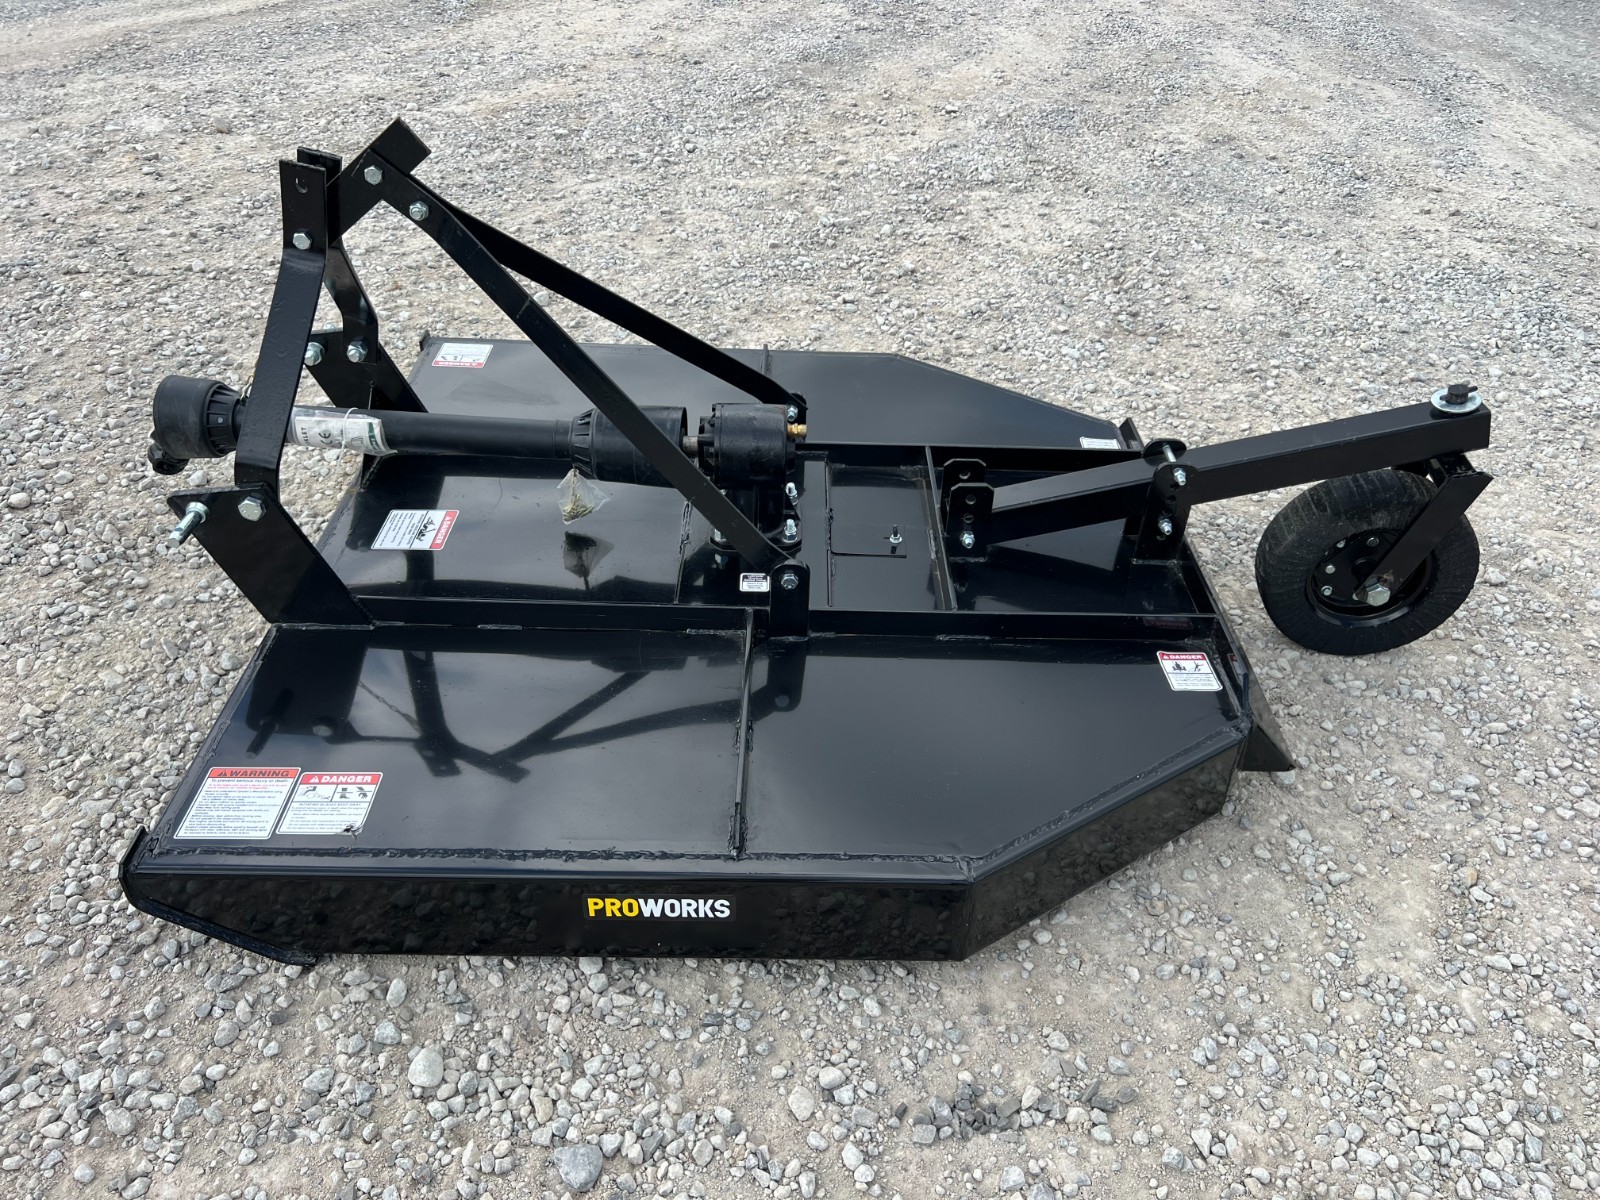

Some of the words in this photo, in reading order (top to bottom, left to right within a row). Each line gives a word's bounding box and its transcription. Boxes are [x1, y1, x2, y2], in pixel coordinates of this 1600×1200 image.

[433, 520, 452, 544] DANGER
[321, 775, 372, 783] DANGER
[587, 897, 731, 918] PROWORKS
